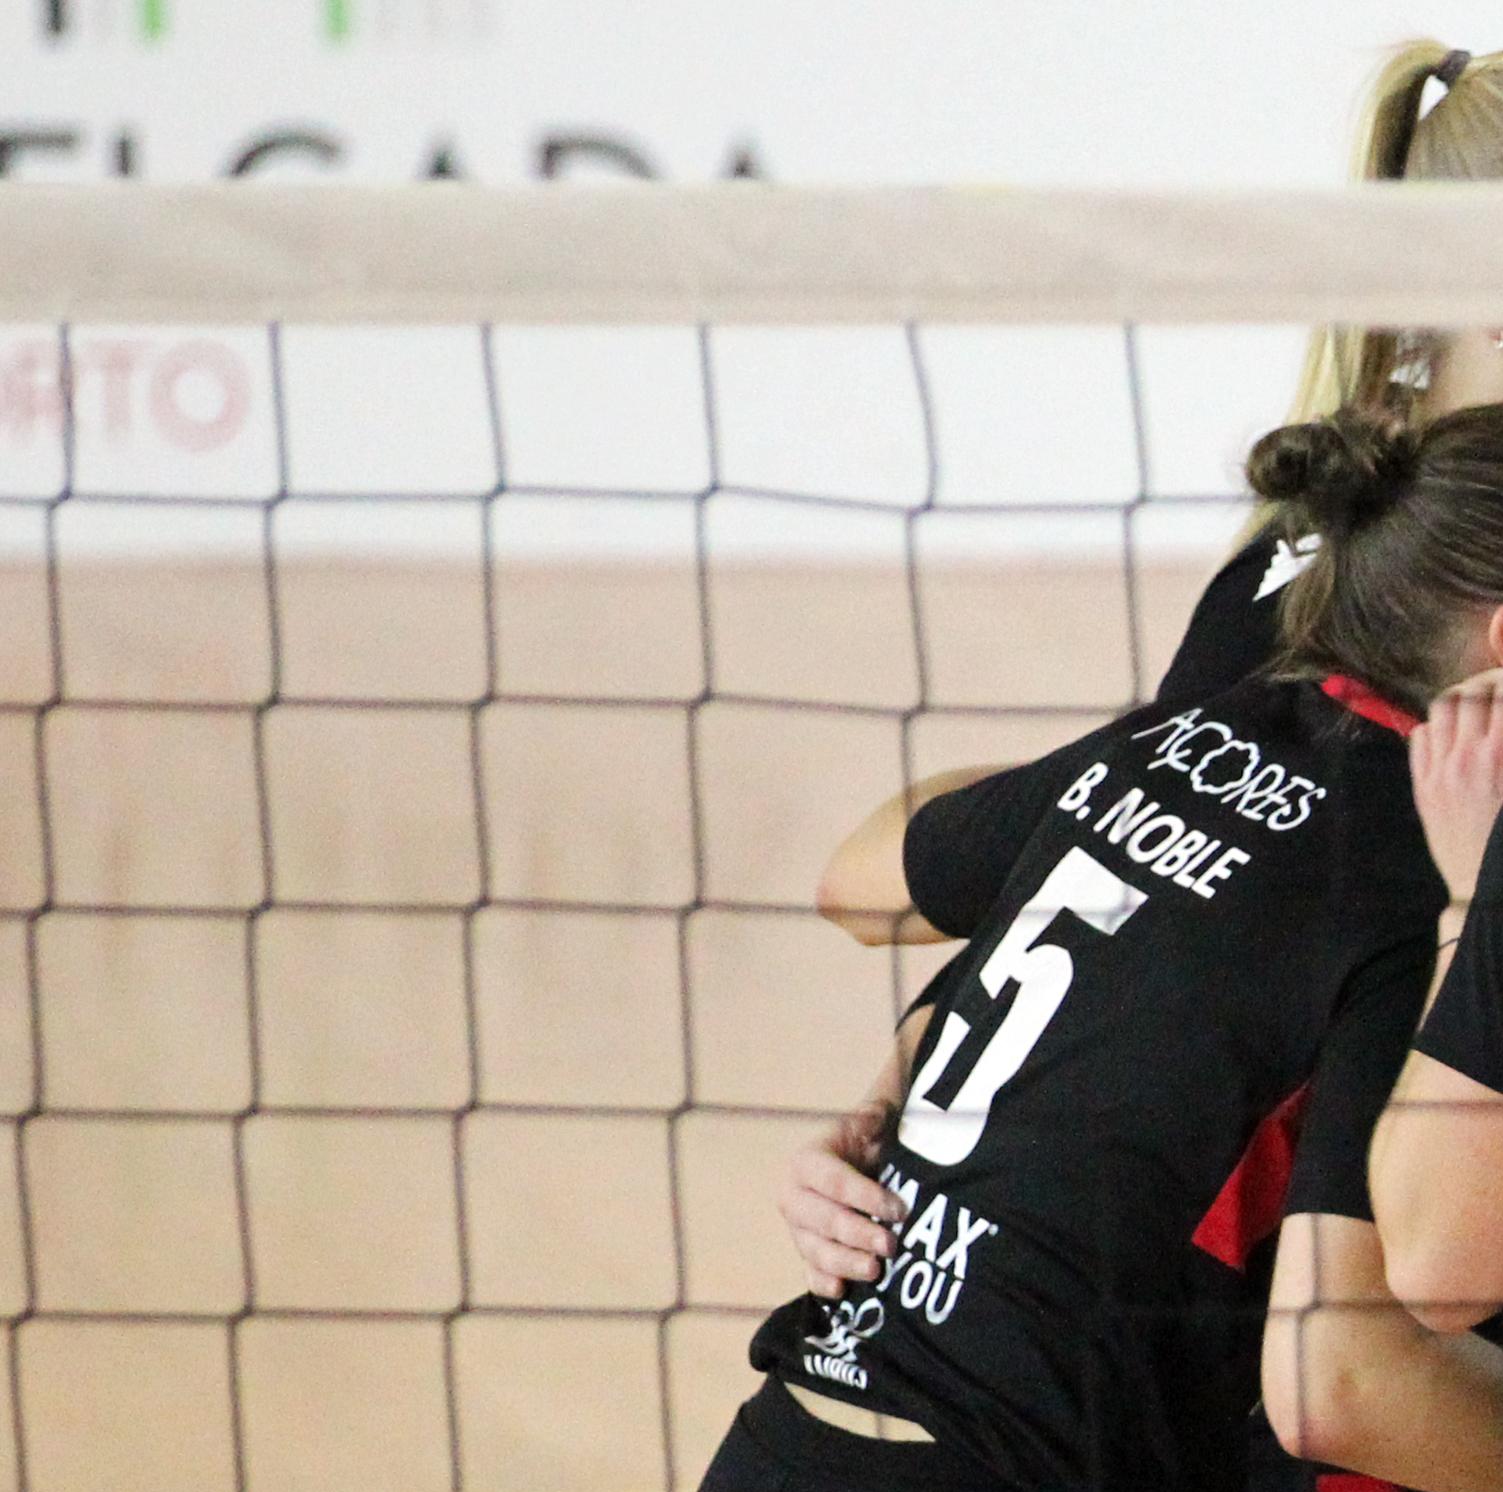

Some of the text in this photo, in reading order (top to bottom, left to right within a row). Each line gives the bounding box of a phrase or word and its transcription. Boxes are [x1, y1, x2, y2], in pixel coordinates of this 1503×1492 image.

[1057, 761, 1251, 899] B. NOBLE
[1131, 707, 1326, 831] AÇORES
[898, 846, 1149, 1166] 5
[876, 1251, 963, 1325] YOU
